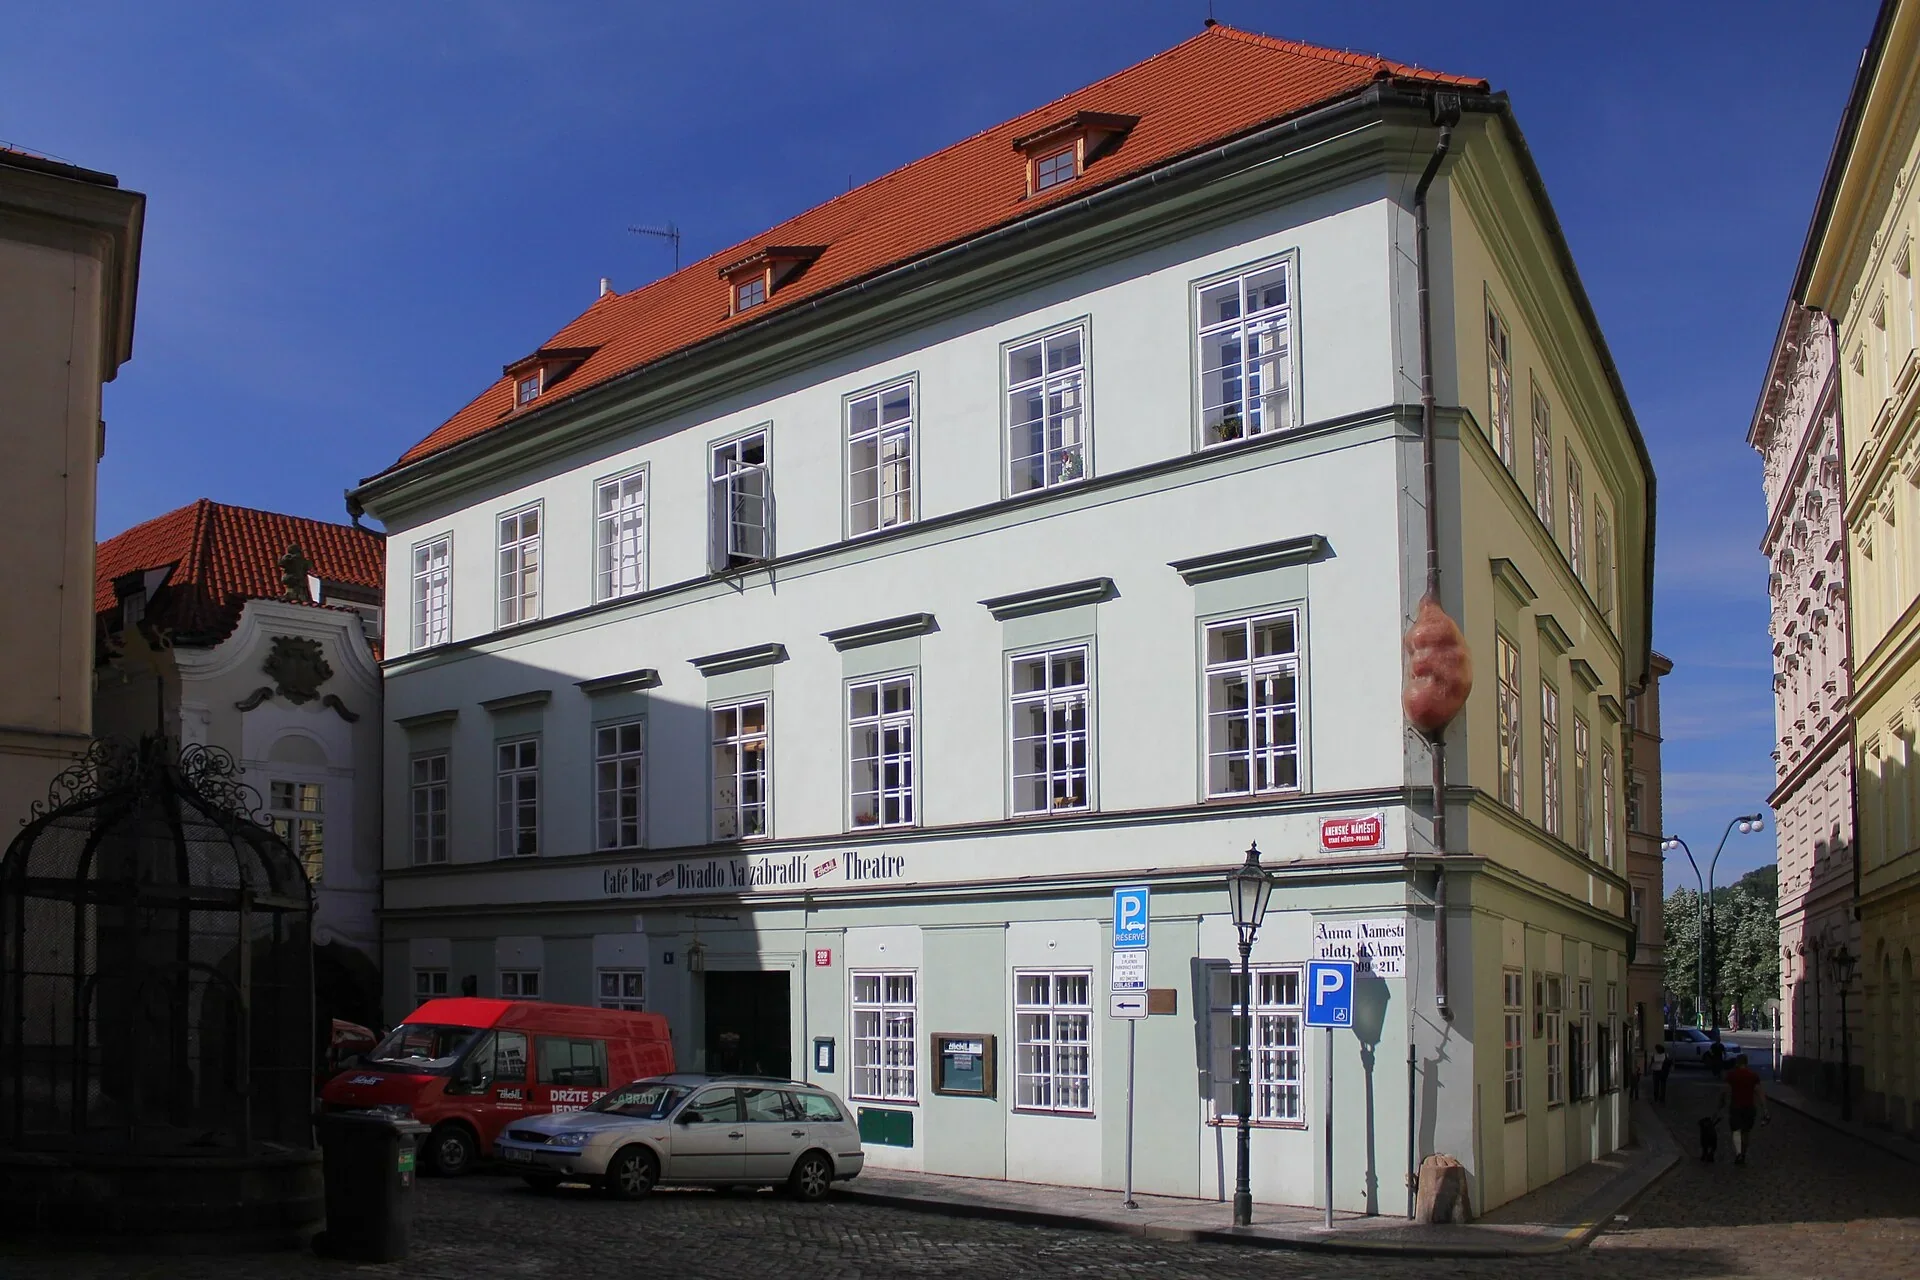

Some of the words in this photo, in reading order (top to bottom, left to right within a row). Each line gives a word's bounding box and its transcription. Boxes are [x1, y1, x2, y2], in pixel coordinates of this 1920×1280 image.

[1325, 823, 1349, 836] ANENSKÉ
[1351, 821, 1377, 834] NÁMĚSTÍ
[604, 868, 628, 894] Café
[632, 867, 652, 892] Bar
[677, 861, 724, 889] Divadlo
[730, 860, 745, 887] Na
[749, 855, 809, 886] zábradlí
[843, 851, 905, 880] Theatre
[1121, 896, 1141, 930] P
[1115, 931, 1145, 942] RÉSERVÉ
[1315, 922, 1352, 939] Anna
[1379, 961, 1399, 972] 211.
[1316, 969, 1344, 1006] P
[550, 1088, 588, 1102] DRŽTE
